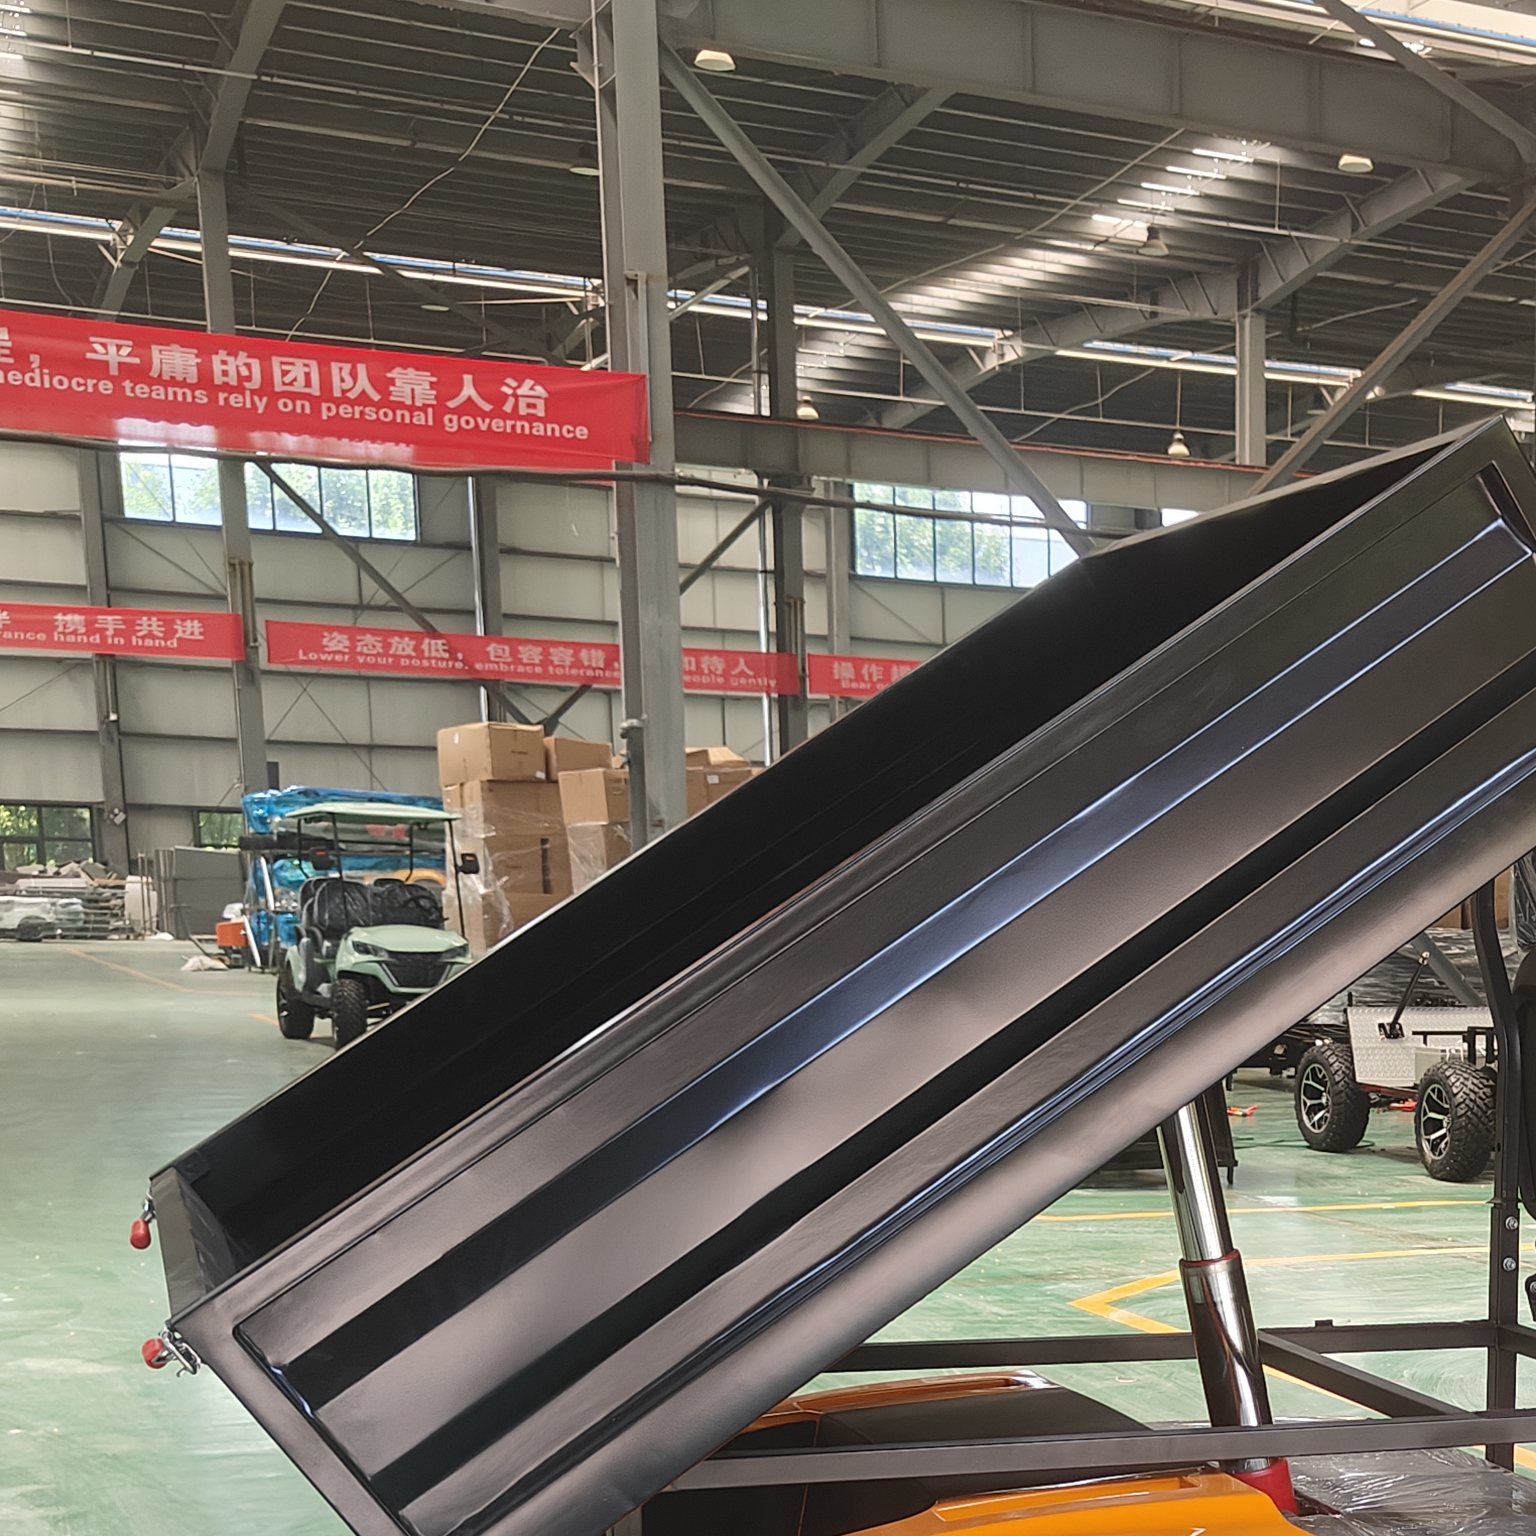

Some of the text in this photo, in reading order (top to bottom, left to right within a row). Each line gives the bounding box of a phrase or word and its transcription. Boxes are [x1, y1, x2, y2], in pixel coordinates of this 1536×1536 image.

[0, 327, 549, 417] ，平庸的团队靠人治
[0, 367, 589, 440] ediocre teams rely on personal governance
[0, 630, 177, 648] ance hand in hand
[299, 649, 349, 662] Lower
[683, 674, 724, 684] eople
